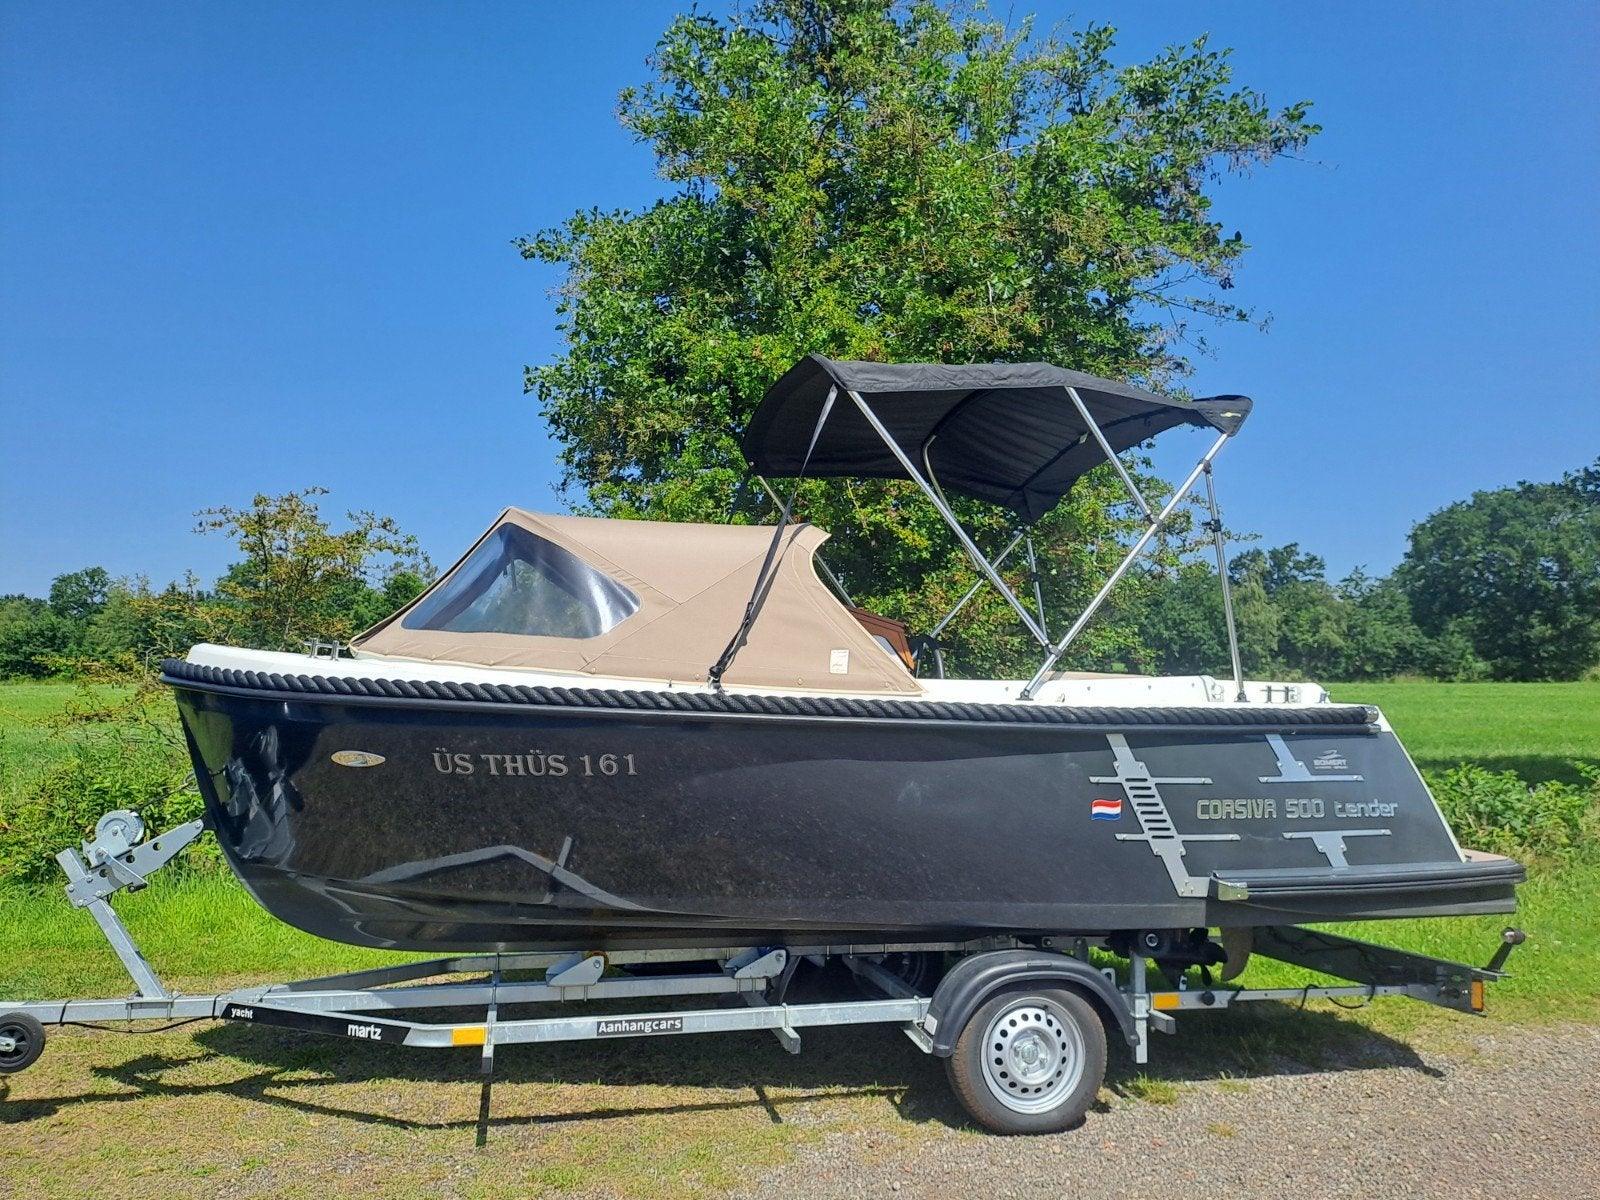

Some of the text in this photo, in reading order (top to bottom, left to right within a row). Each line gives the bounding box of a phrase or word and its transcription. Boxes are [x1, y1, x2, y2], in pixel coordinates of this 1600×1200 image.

[432, 747, 638, 776] ÜS THÜS 161
[1285, 799, 1325, 818] 500
[1334, 798, 1398, 818] tender
[231, 1007, 253, 1019] yacht
[348, 1023, 382, 1040] martz
[598, 1019, 682, 1033] Aanhangcars
